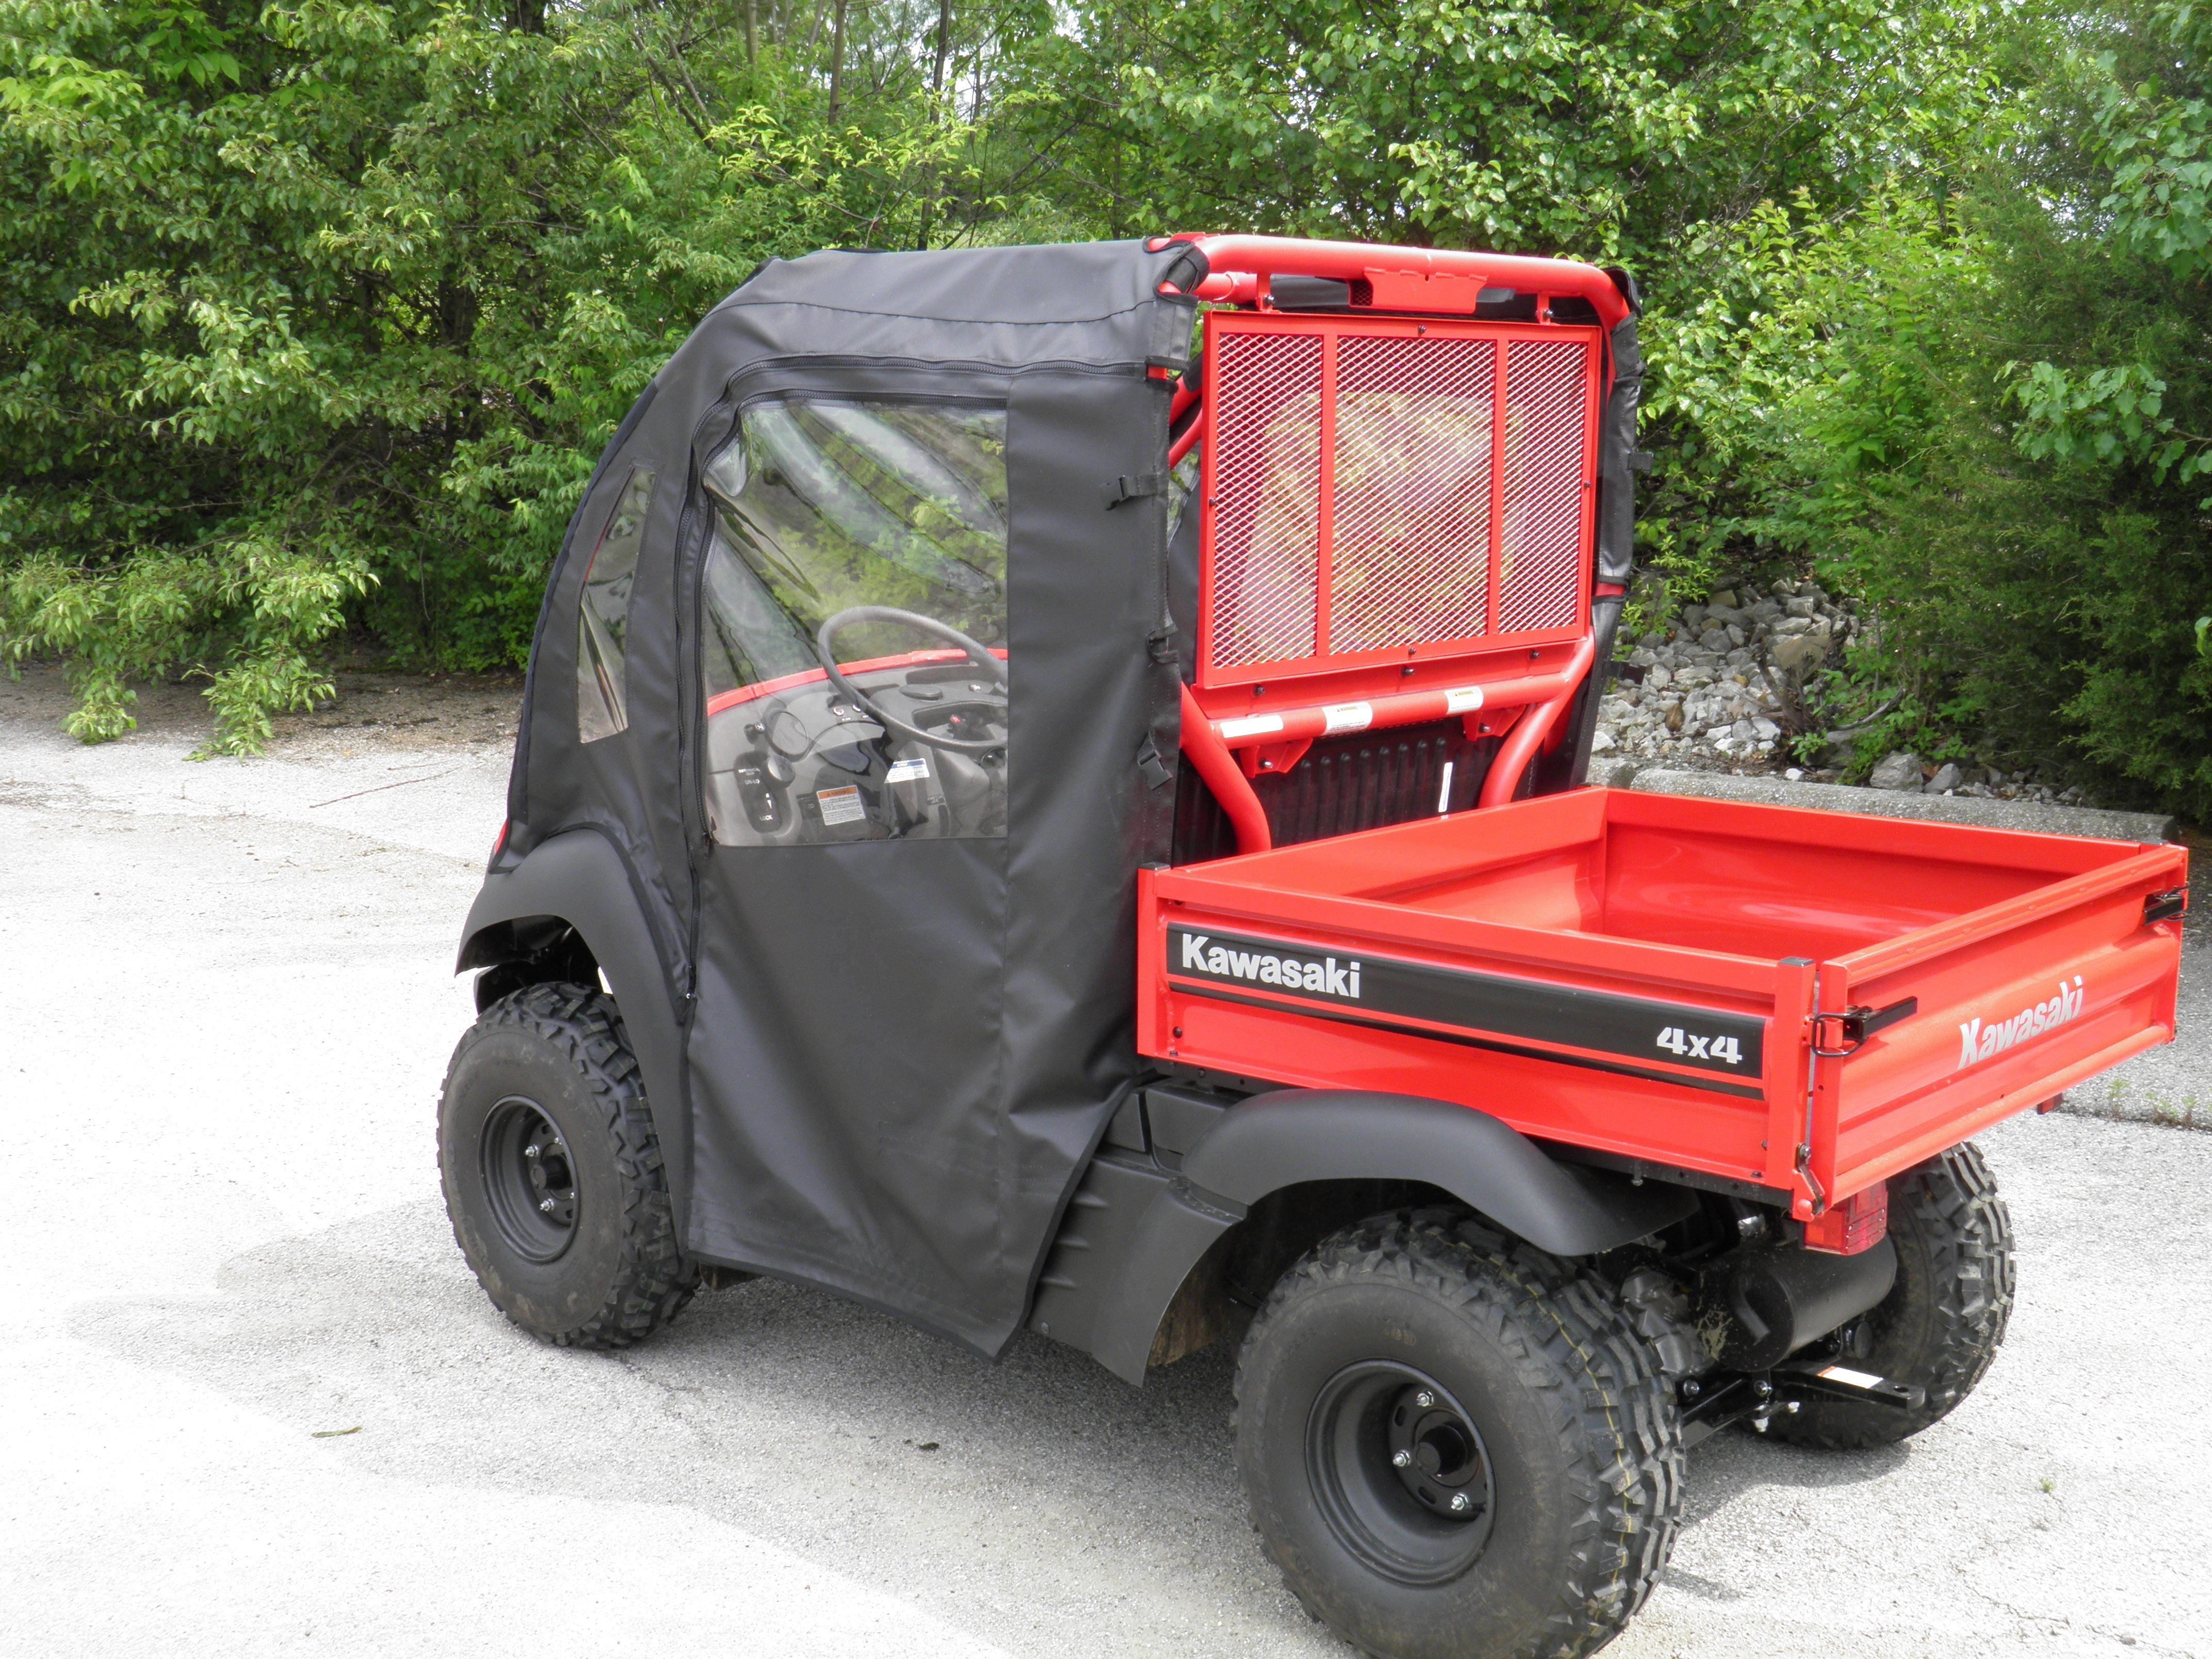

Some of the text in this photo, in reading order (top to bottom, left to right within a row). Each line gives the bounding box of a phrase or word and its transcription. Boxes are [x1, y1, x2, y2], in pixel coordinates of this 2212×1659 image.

[1182, 933, 1360, 999] Kawasaki
[1656, 1027, 1743, 1064] 4x4
[1957, 975, 2083, 1070] Kawasaki
